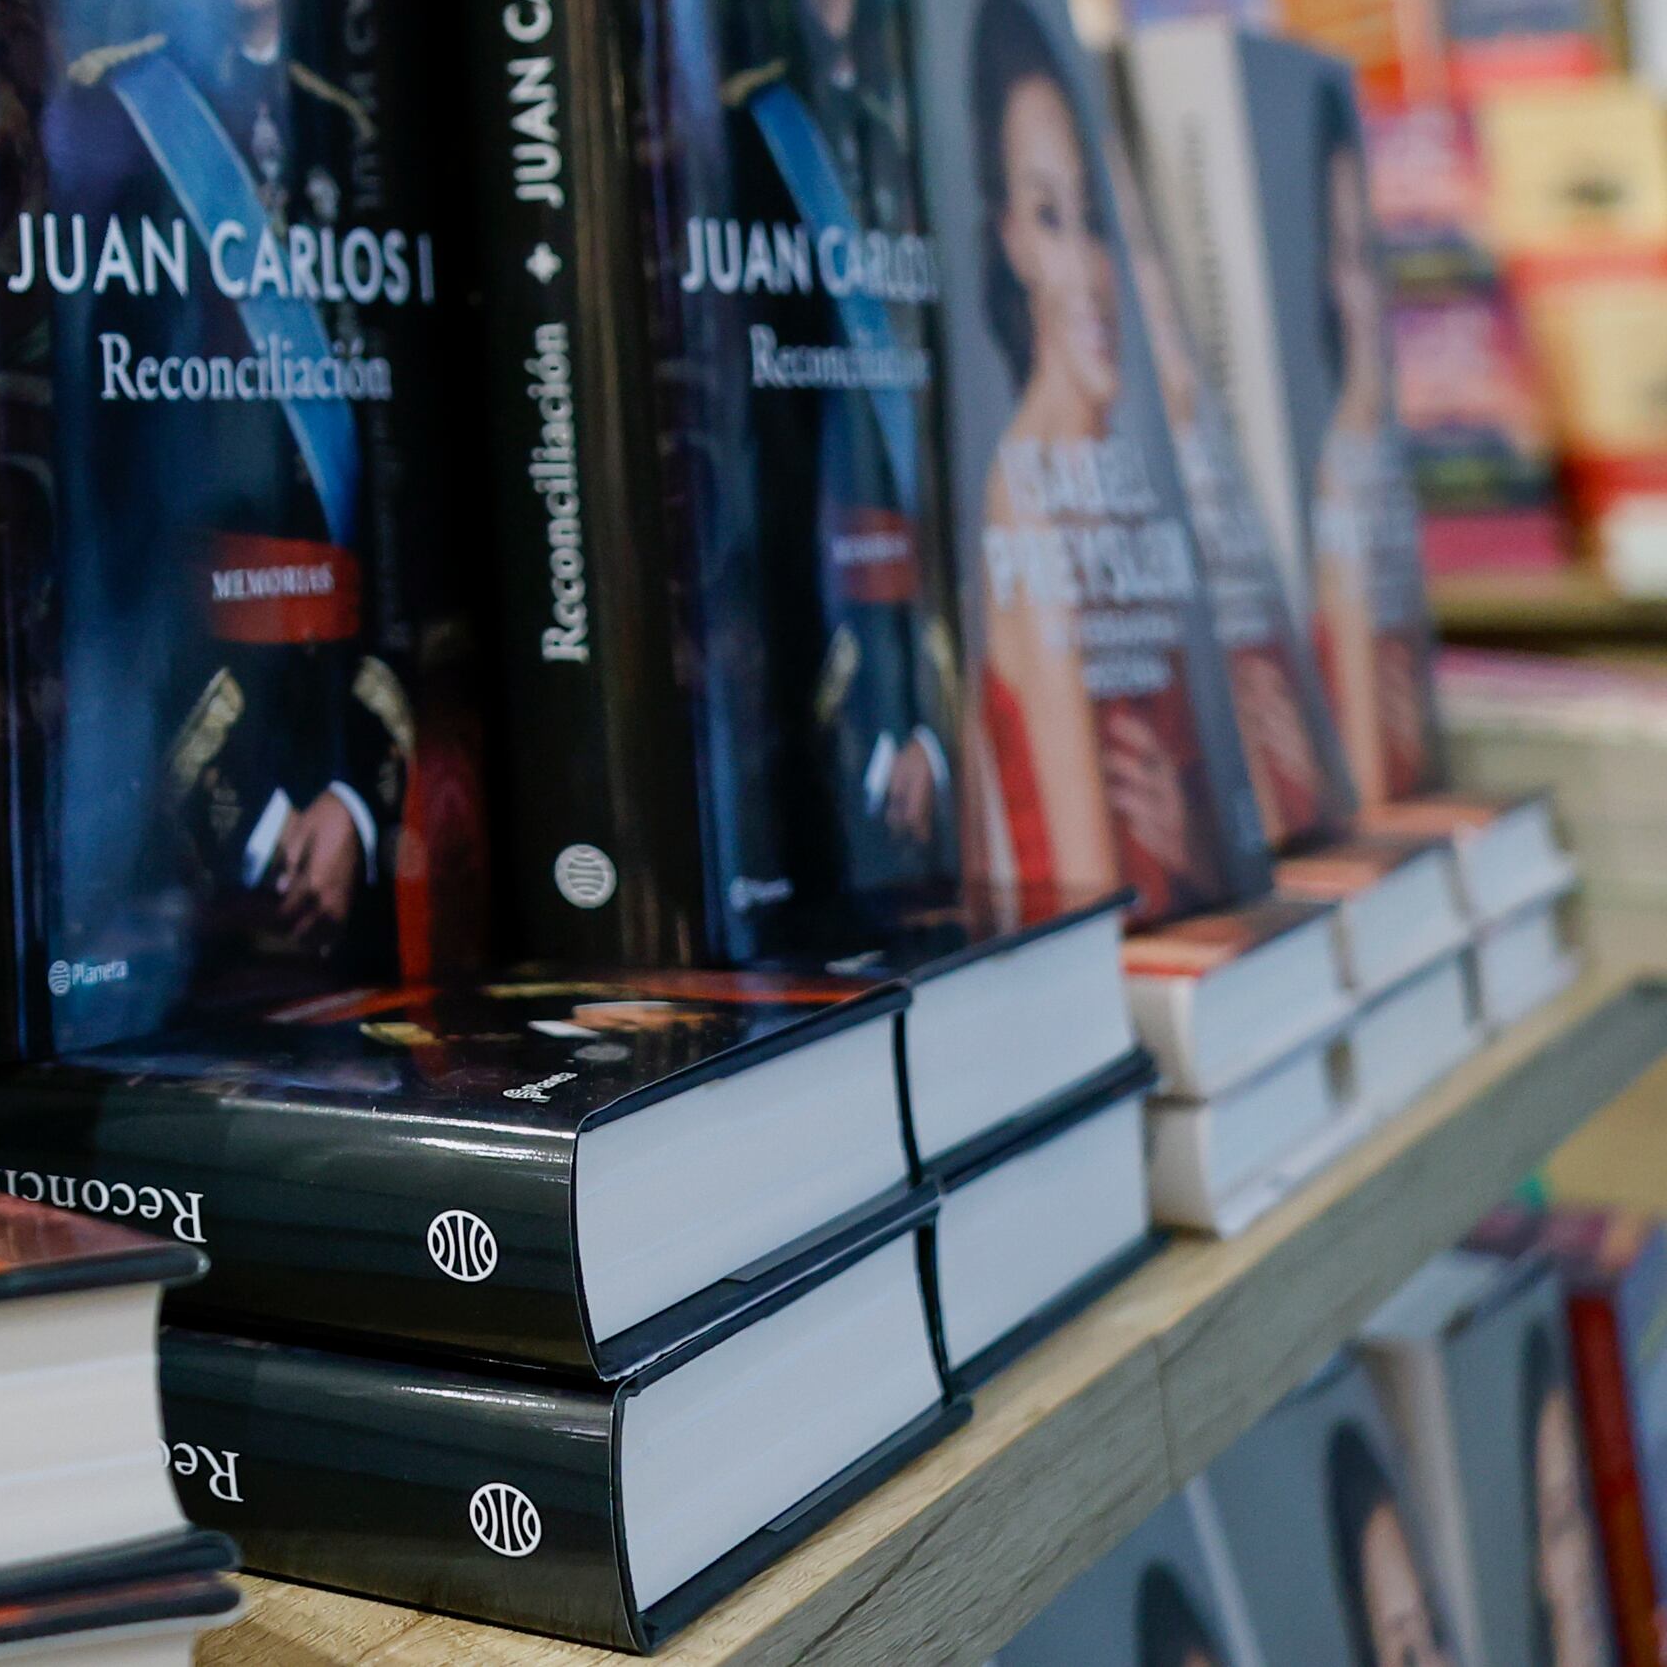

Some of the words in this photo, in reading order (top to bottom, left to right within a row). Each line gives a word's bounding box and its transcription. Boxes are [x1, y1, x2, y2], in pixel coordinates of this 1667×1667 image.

[513, 55, 562, 210] JUAN
[6, 211, 189, 298] JUAN
[209, 218, 411, 304] CARLOS
[416, 232, 435, 305] I
[681, 214, 814, 296] JUAN
[99, 332, 393, 402] Reconciliación
[527, 322, 589, 664] Reconciliación
